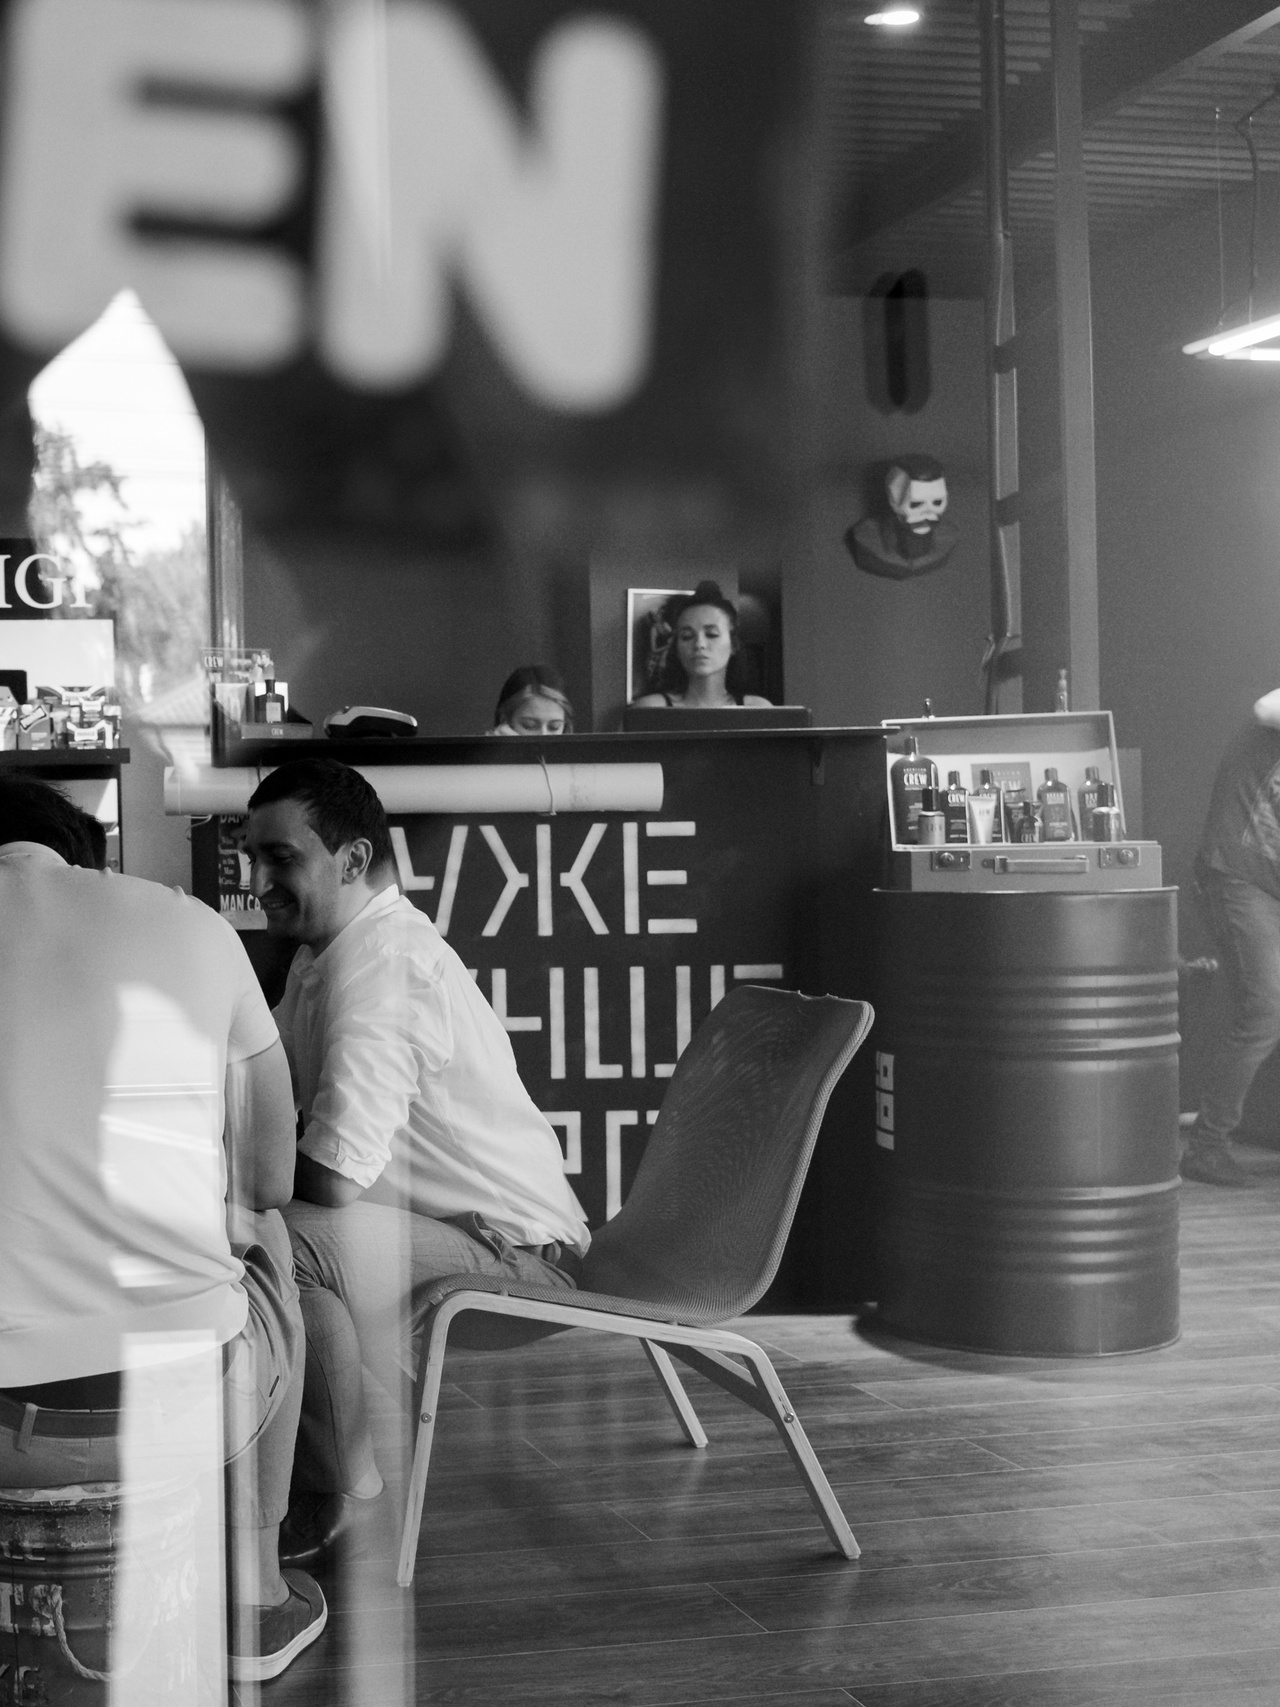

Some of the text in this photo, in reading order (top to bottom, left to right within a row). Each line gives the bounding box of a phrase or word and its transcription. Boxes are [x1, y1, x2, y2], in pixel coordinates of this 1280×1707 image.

[903, 773, 927, 786] CREW
[220, 893, 264, 911] MAN CA
